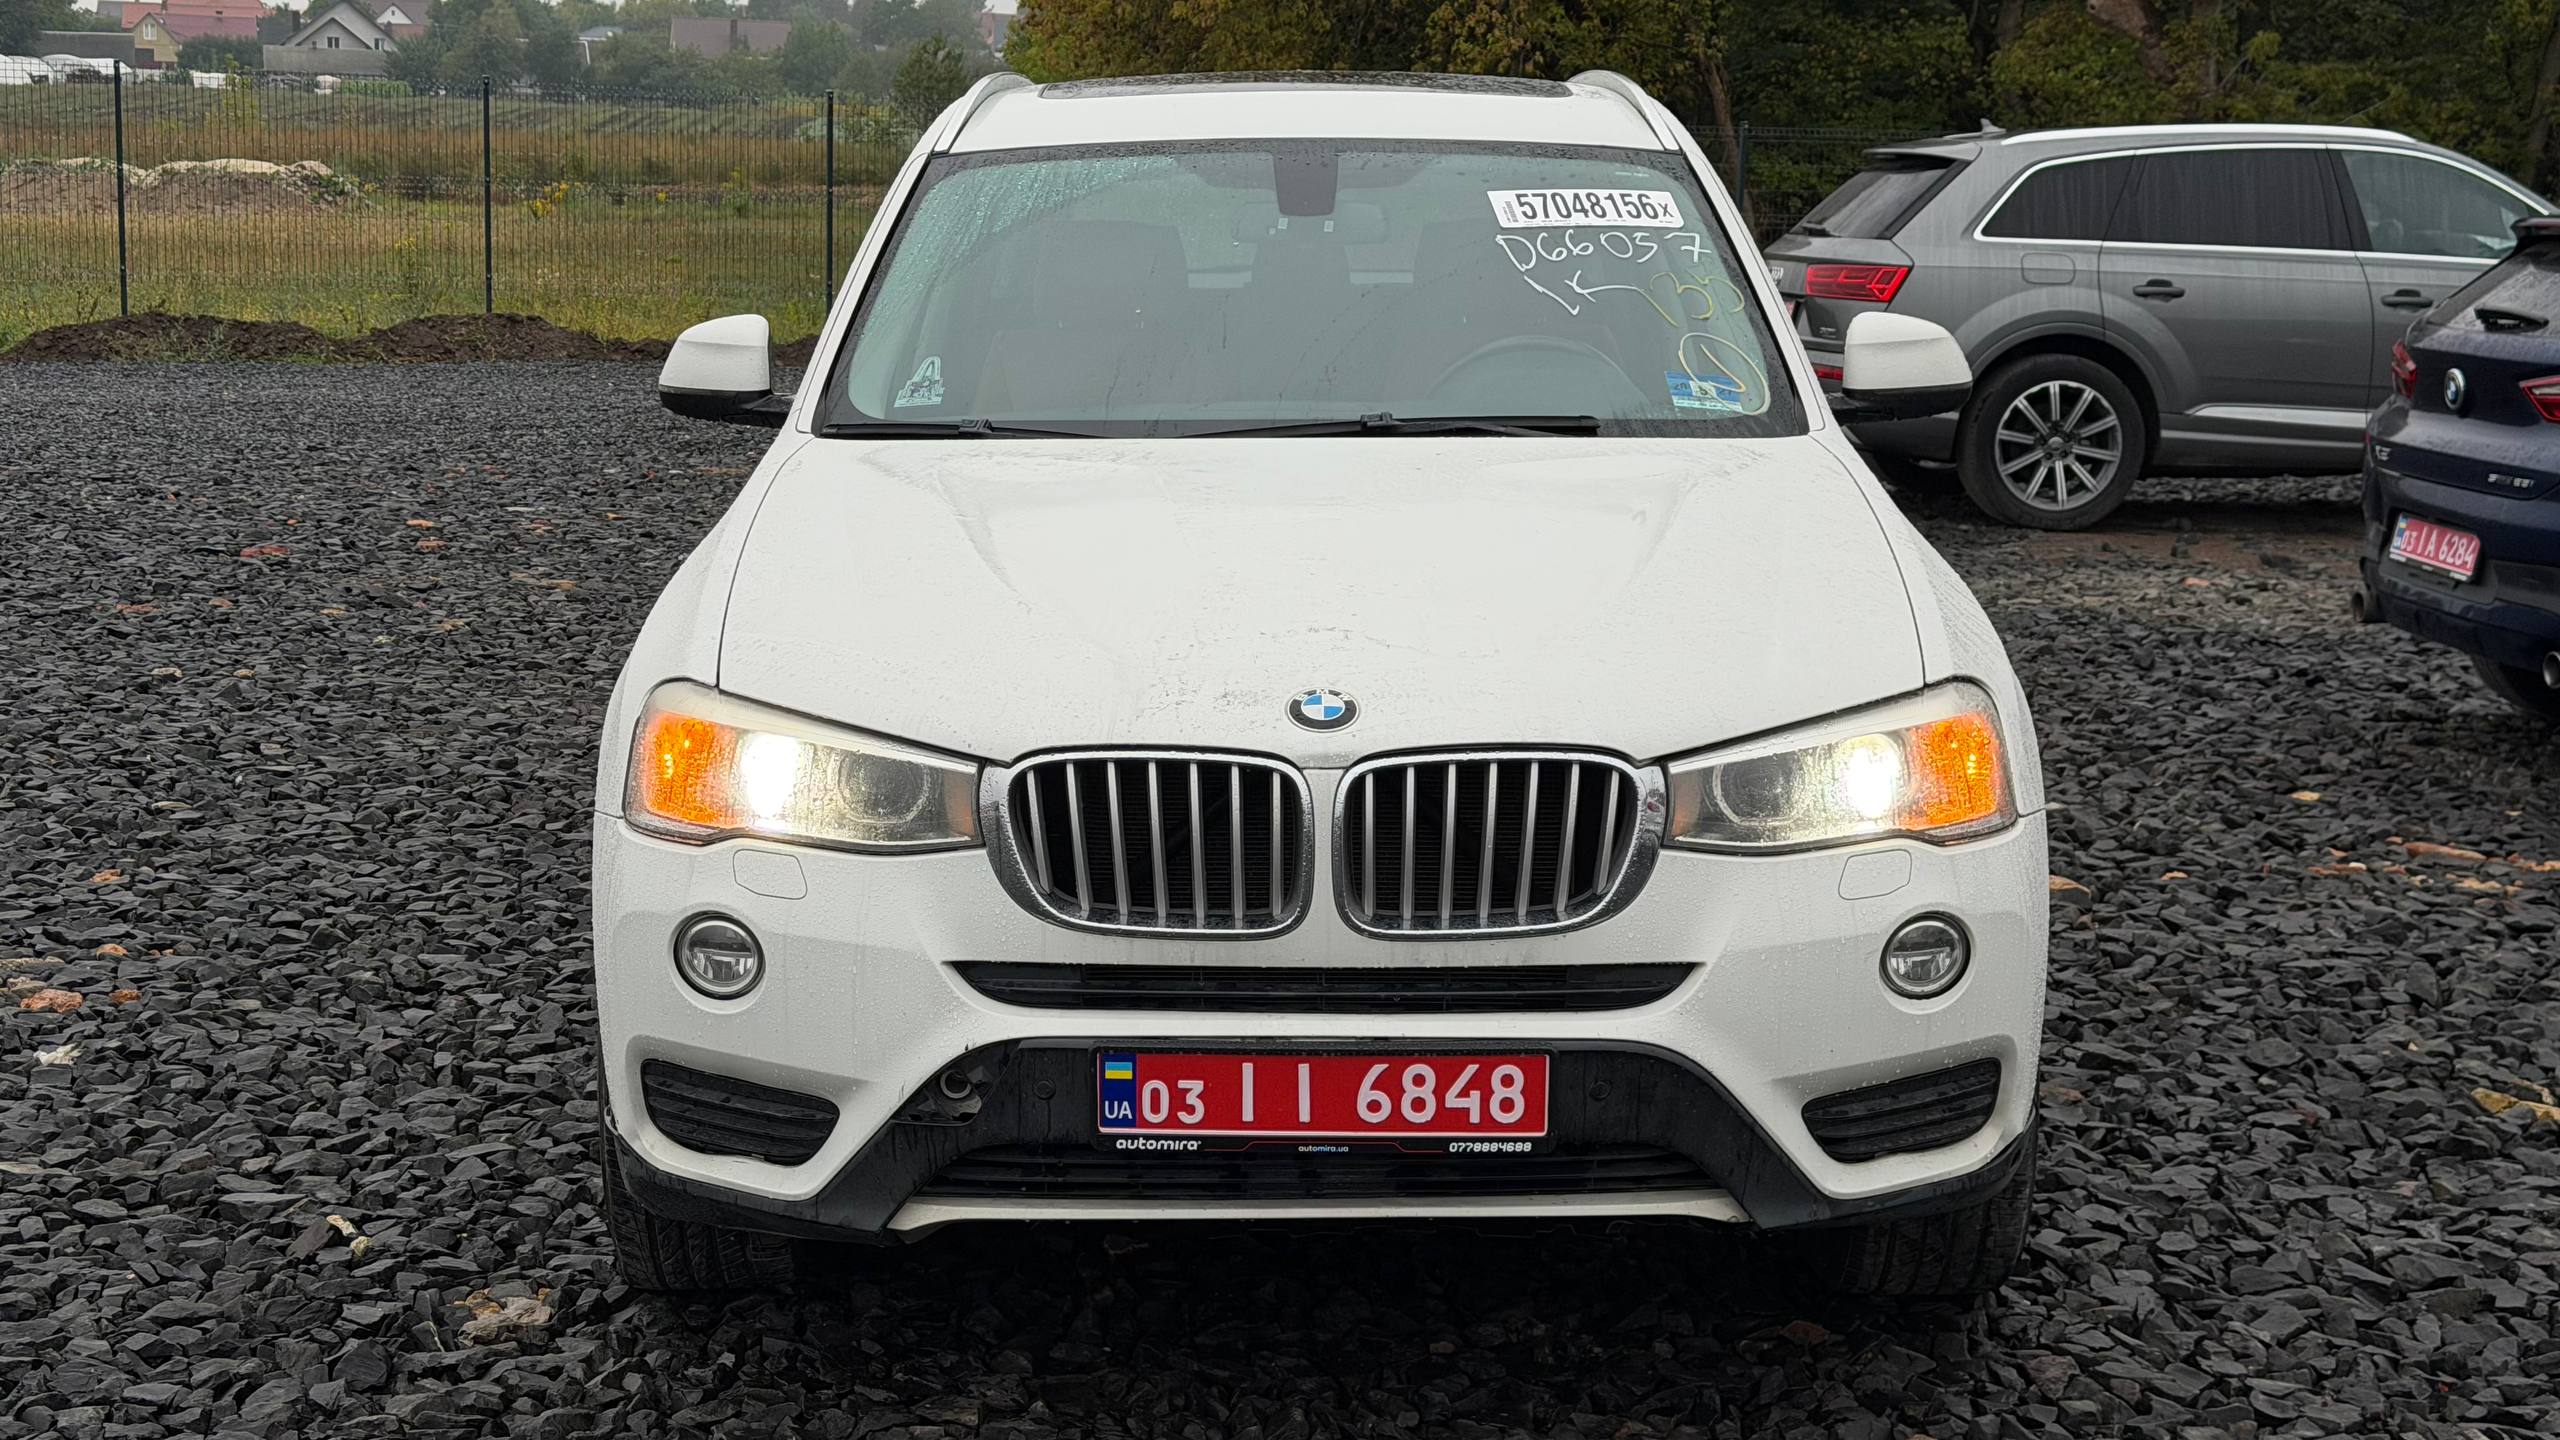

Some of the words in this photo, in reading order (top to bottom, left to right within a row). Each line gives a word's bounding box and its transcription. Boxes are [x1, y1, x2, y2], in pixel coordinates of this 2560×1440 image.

[1514, 192, 1660, 220] 57048156
[1495, 229, 1711, 272] D66057
[2439, 532, 2476, 569] 6284
[1142, 1079, 1205, 1125] 03
[1356, 1063, 1525, 1124] 6848
[1104, 1100, 1133, 1120] UA
[1115, 1136, 1199, 1151] automira
[1298, 1144, 1349, 1153] automira.ua
